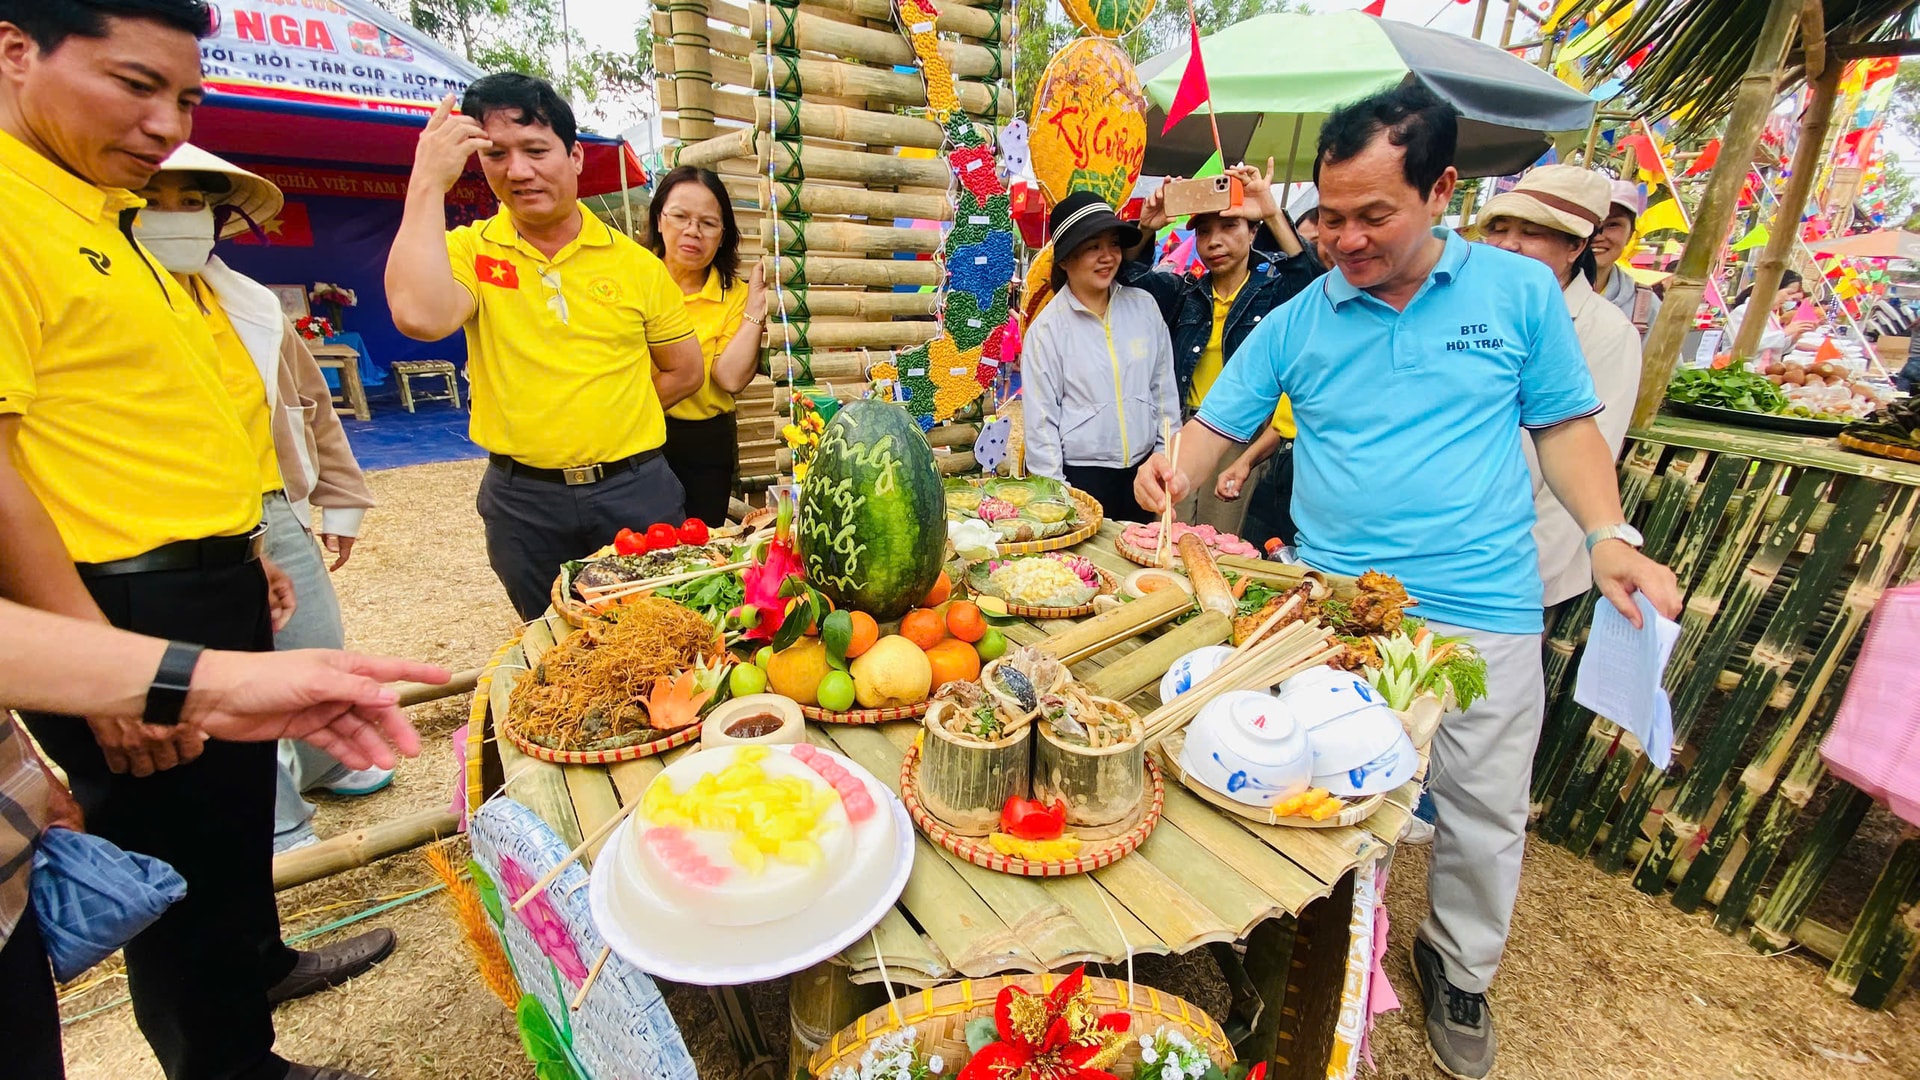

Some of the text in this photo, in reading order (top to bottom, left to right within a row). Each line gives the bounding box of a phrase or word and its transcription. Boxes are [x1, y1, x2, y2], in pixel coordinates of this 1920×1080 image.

[233, 9, 338, 54] NGA
[309, 58, 347, 76] TÂN
[352, 65, 386, 81] GIA
[402, 72, 438, 90] HỌP
[322, 175, 359, 194] VIỆT
[363, 181, 398, 195] NAM
[1460, 323, 1488, 336] BTC
[1446, 339, 1470, 352] HỘI
